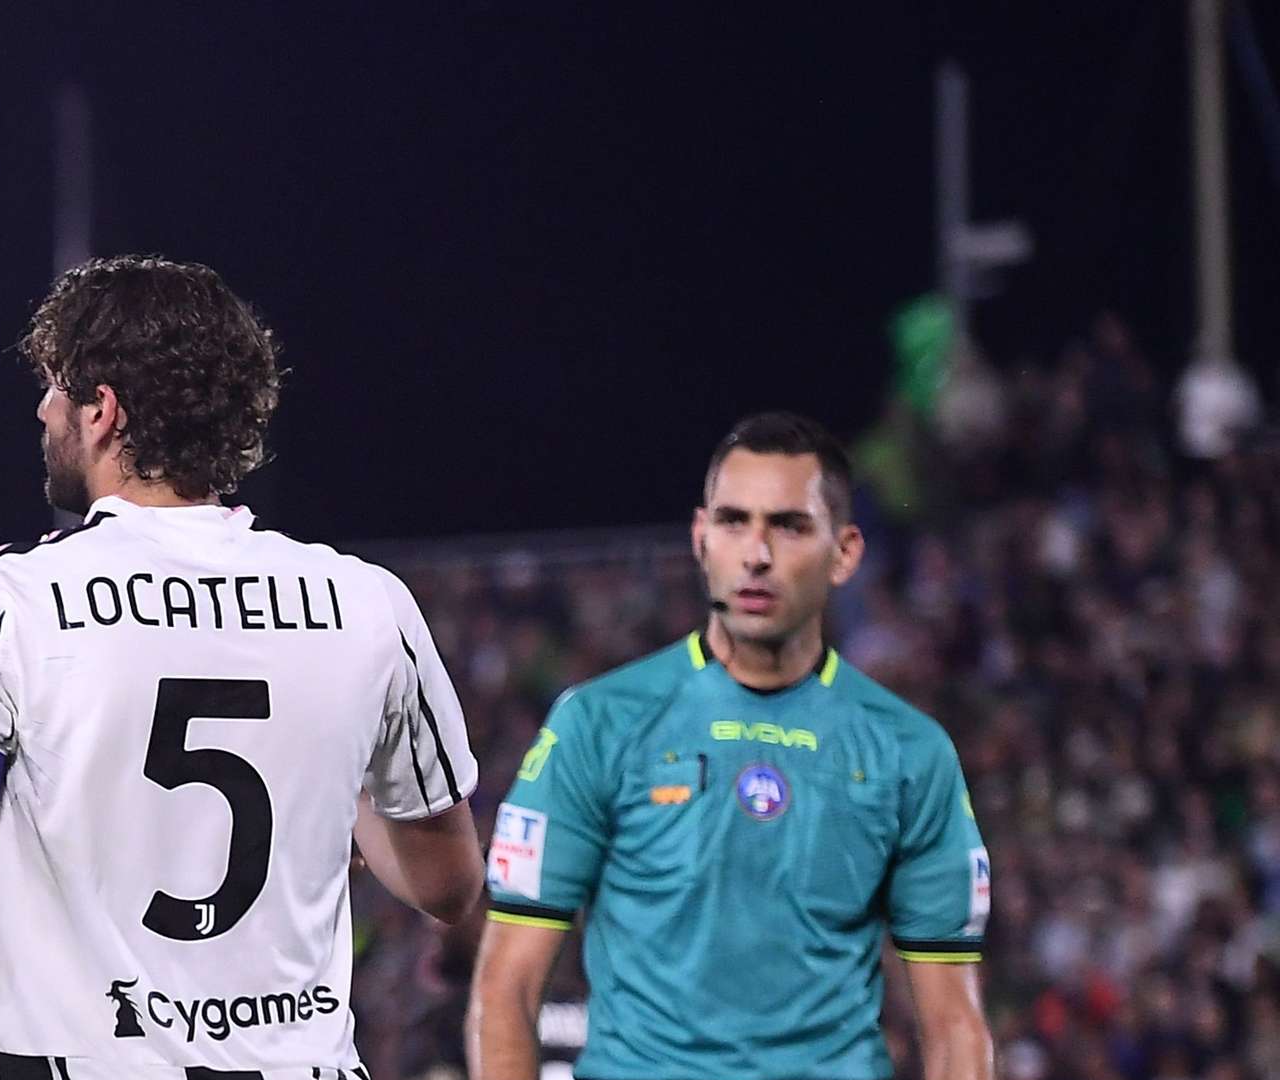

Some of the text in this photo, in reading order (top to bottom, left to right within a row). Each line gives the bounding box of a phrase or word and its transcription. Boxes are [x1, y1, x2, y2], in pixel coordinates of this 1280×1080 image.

[51, 573, 343, 630] LOCATELLI
[142, 677, 273, 941] 5
[148, 985, 339, 1042] Cygames
